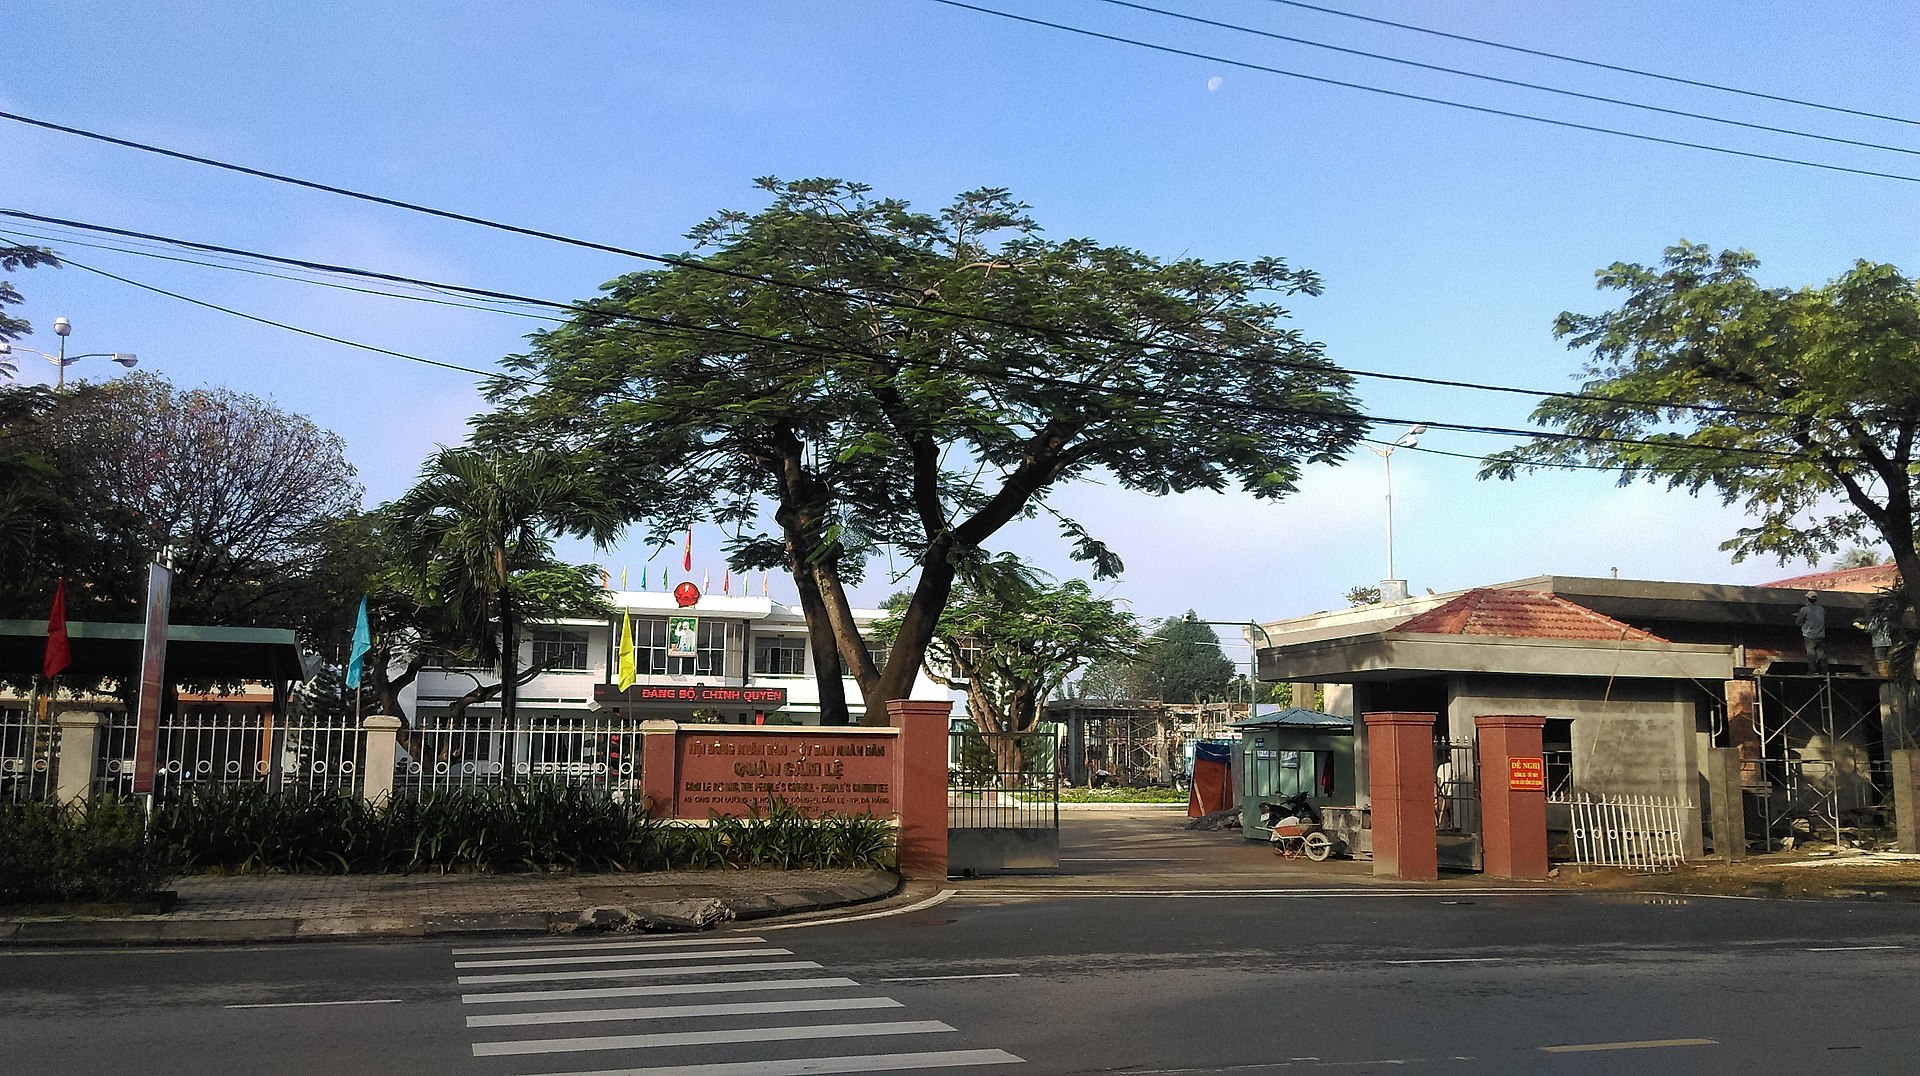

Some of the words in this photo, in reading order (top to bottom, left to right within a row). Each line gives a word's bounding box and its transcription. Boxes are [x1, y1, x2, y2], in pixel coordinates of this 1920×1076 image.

[702, 688, 739, 699] CHÍNH
[744, 688, 781, 702] QUYỀN
[825, 758, 843, 779] LỆ
